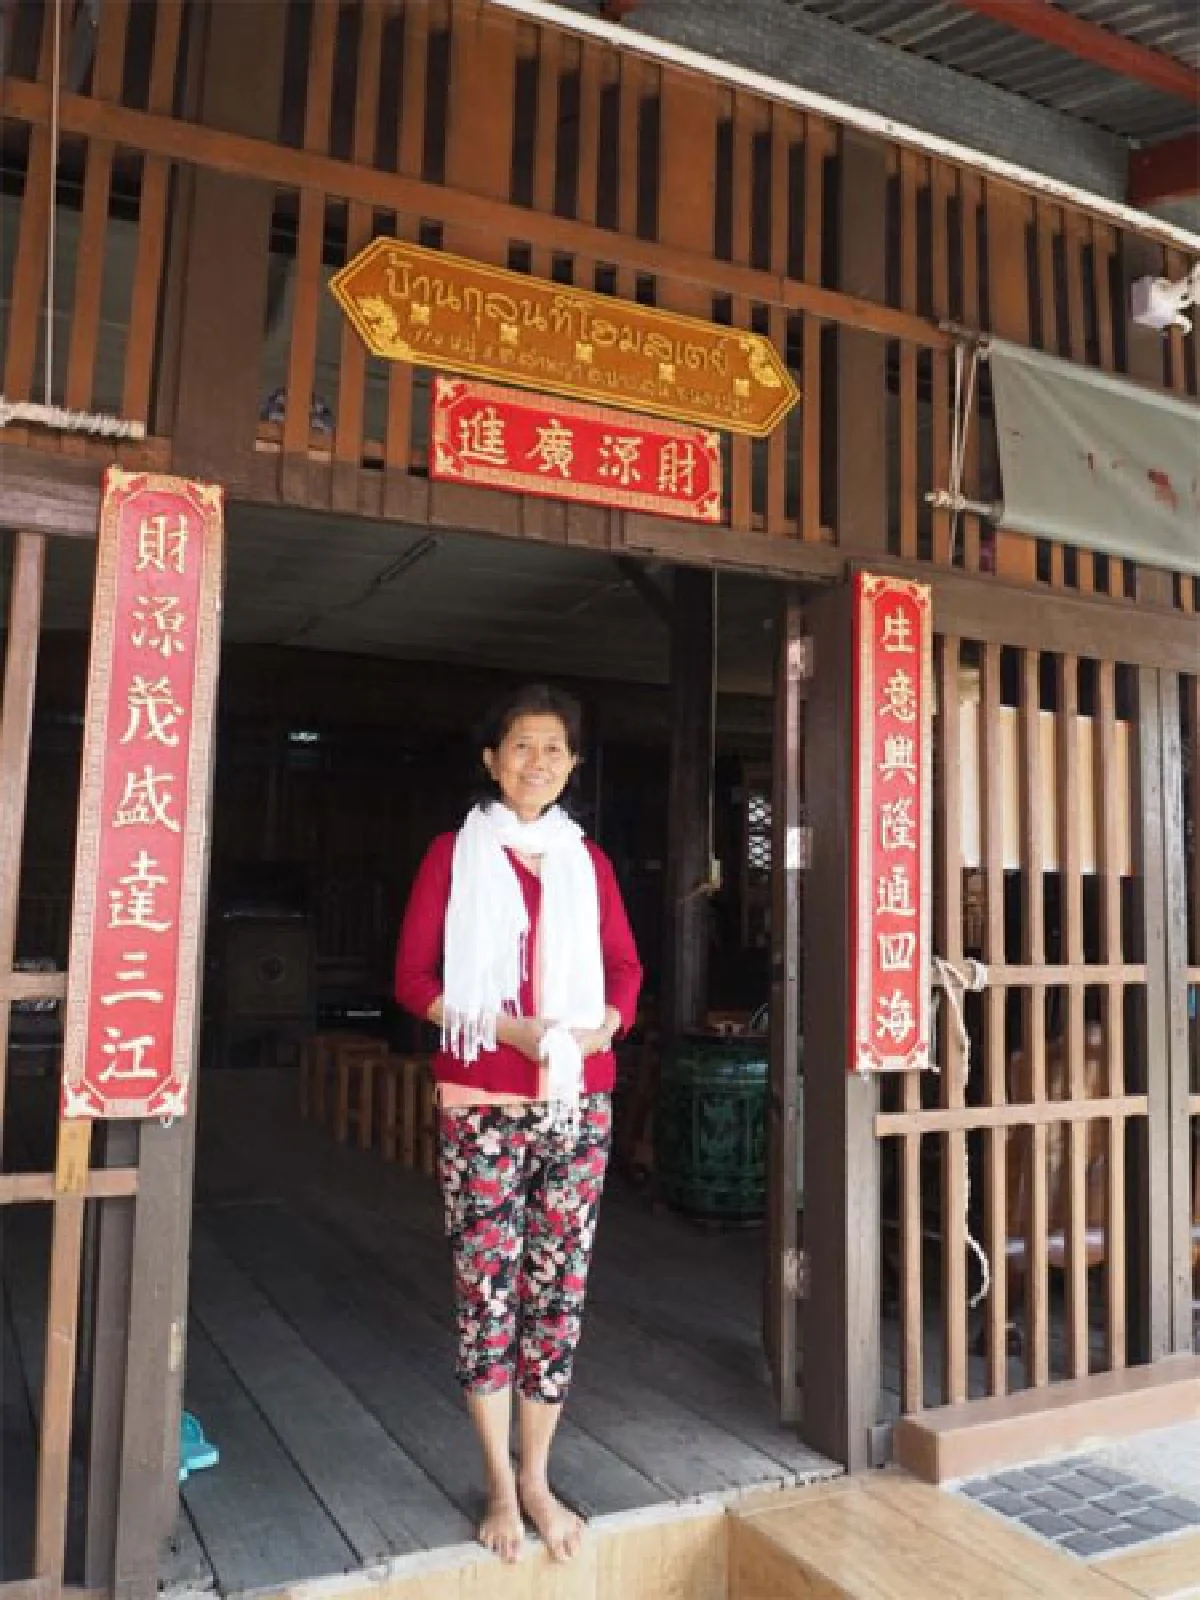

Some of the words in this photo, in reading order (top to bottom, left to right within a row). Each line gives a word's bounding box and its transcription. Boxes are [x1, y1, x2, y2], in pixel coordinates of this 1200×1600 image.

[875, 607, 919, 1045] 生意興隆通四海
